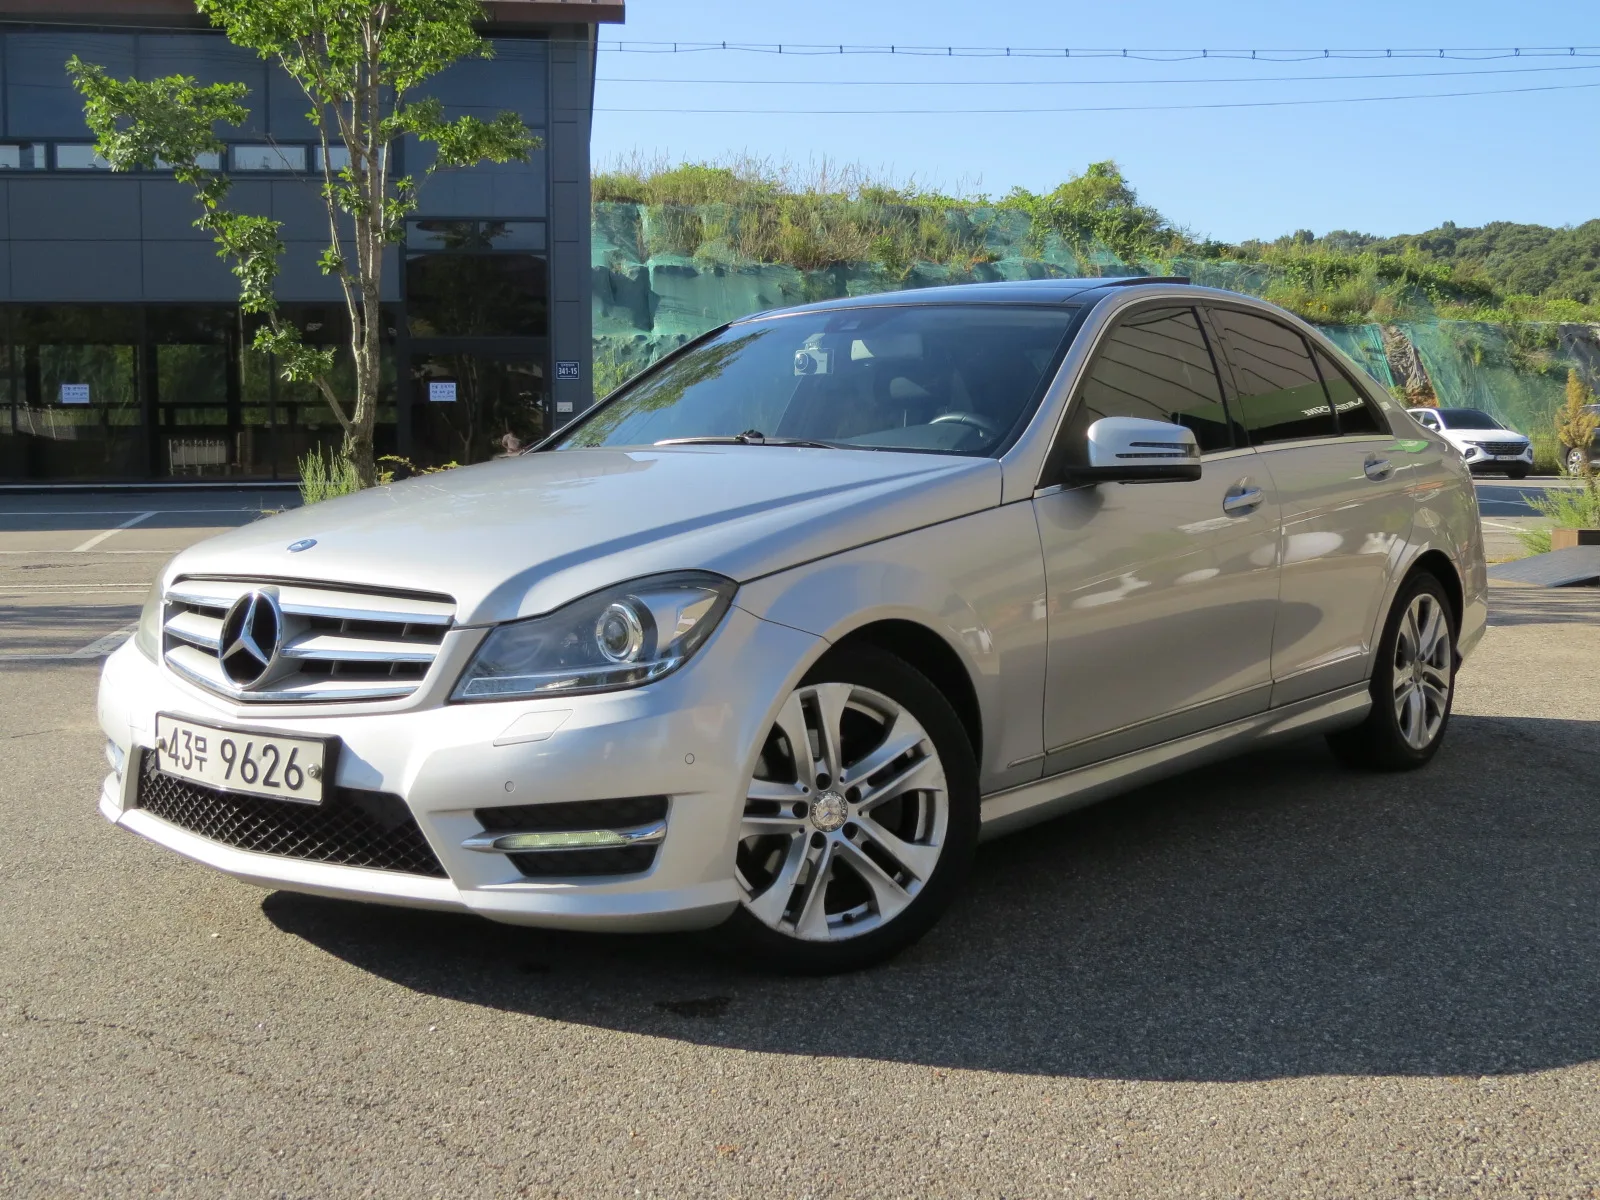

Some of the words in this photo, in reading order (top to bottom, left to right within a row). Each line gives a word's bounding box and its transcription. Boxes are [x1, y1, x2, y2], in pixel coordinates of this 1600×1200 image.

[558, 367, 578, 375] 341-15
[168, 727, 208, 772] 43무
[220, 738, 304, 791] 9626
